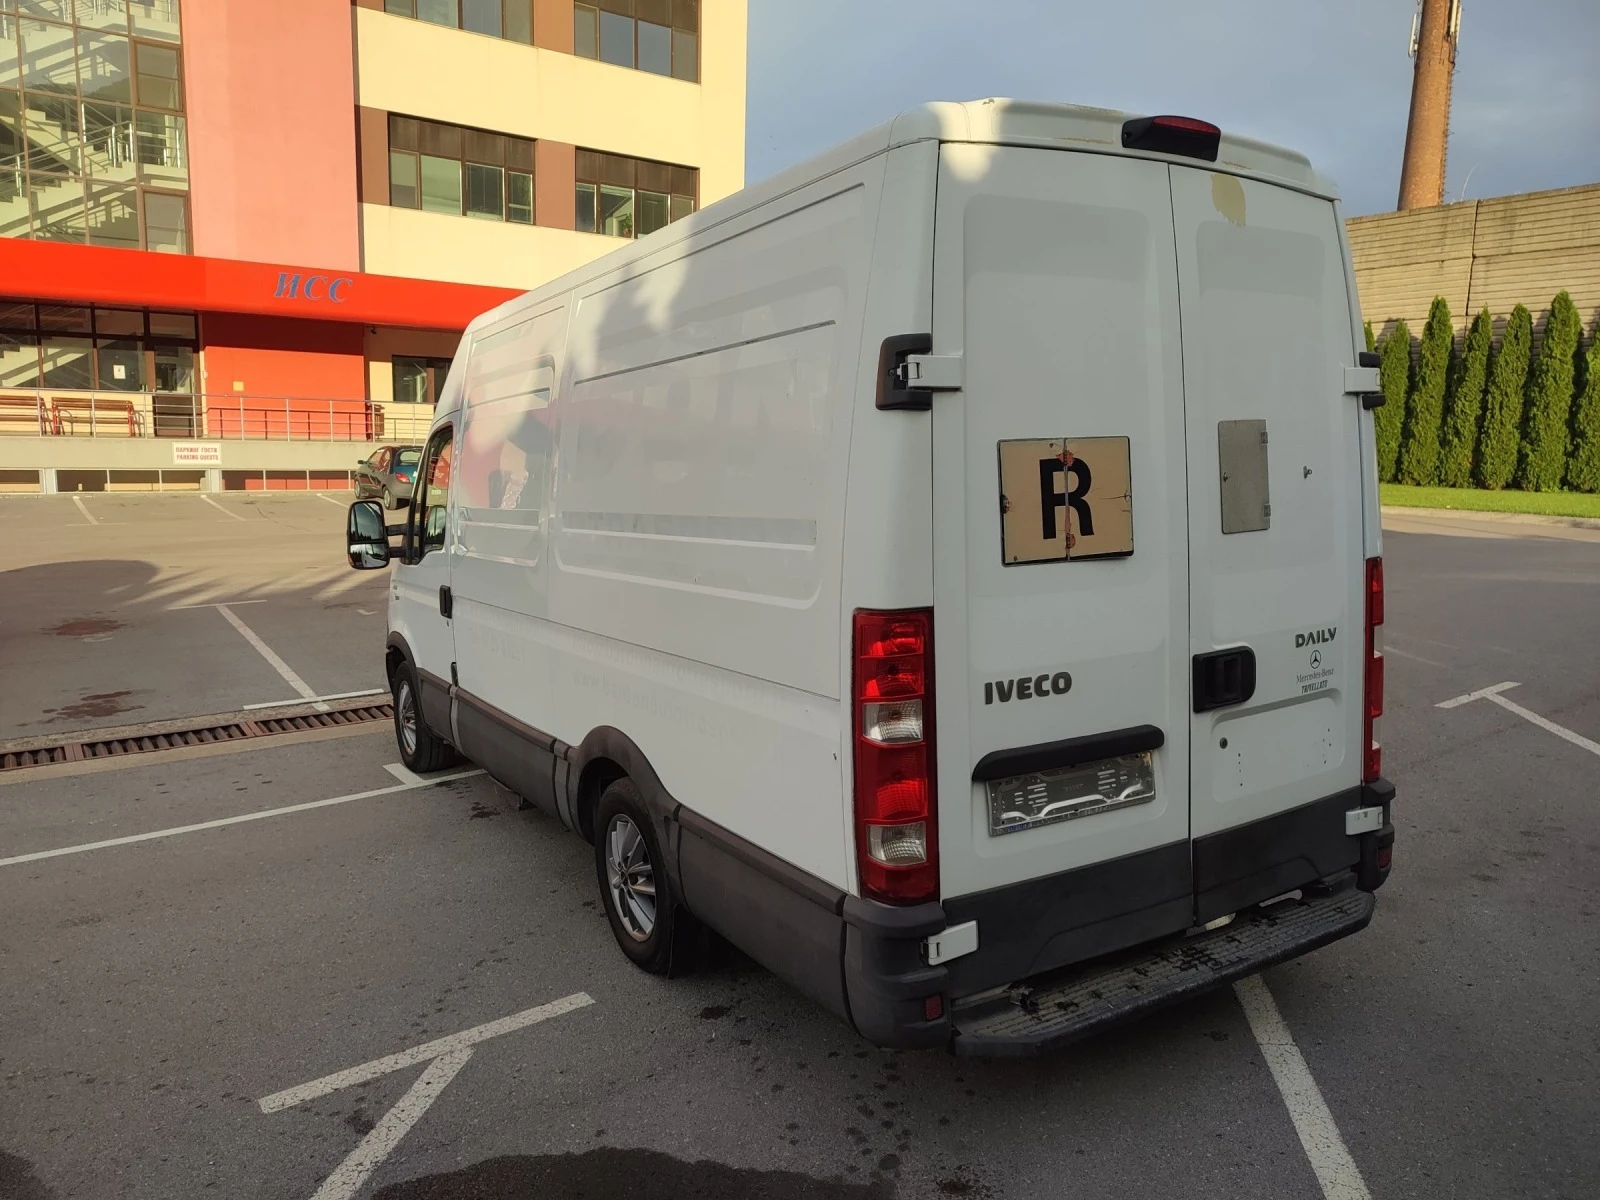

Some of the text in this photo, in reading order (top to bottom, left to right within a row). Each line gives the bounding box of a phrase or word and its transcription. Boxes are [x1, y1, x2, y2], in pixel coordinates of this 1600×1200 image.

[273, 271, 353, 303] ИСС
[1039, 457, 1095, 540] R
[1295, 627, 1337, 648] DAILY
[984, 671, 1073, 705] IVECO
[1296, 668, 1334, 683] Mercedes-Benz
